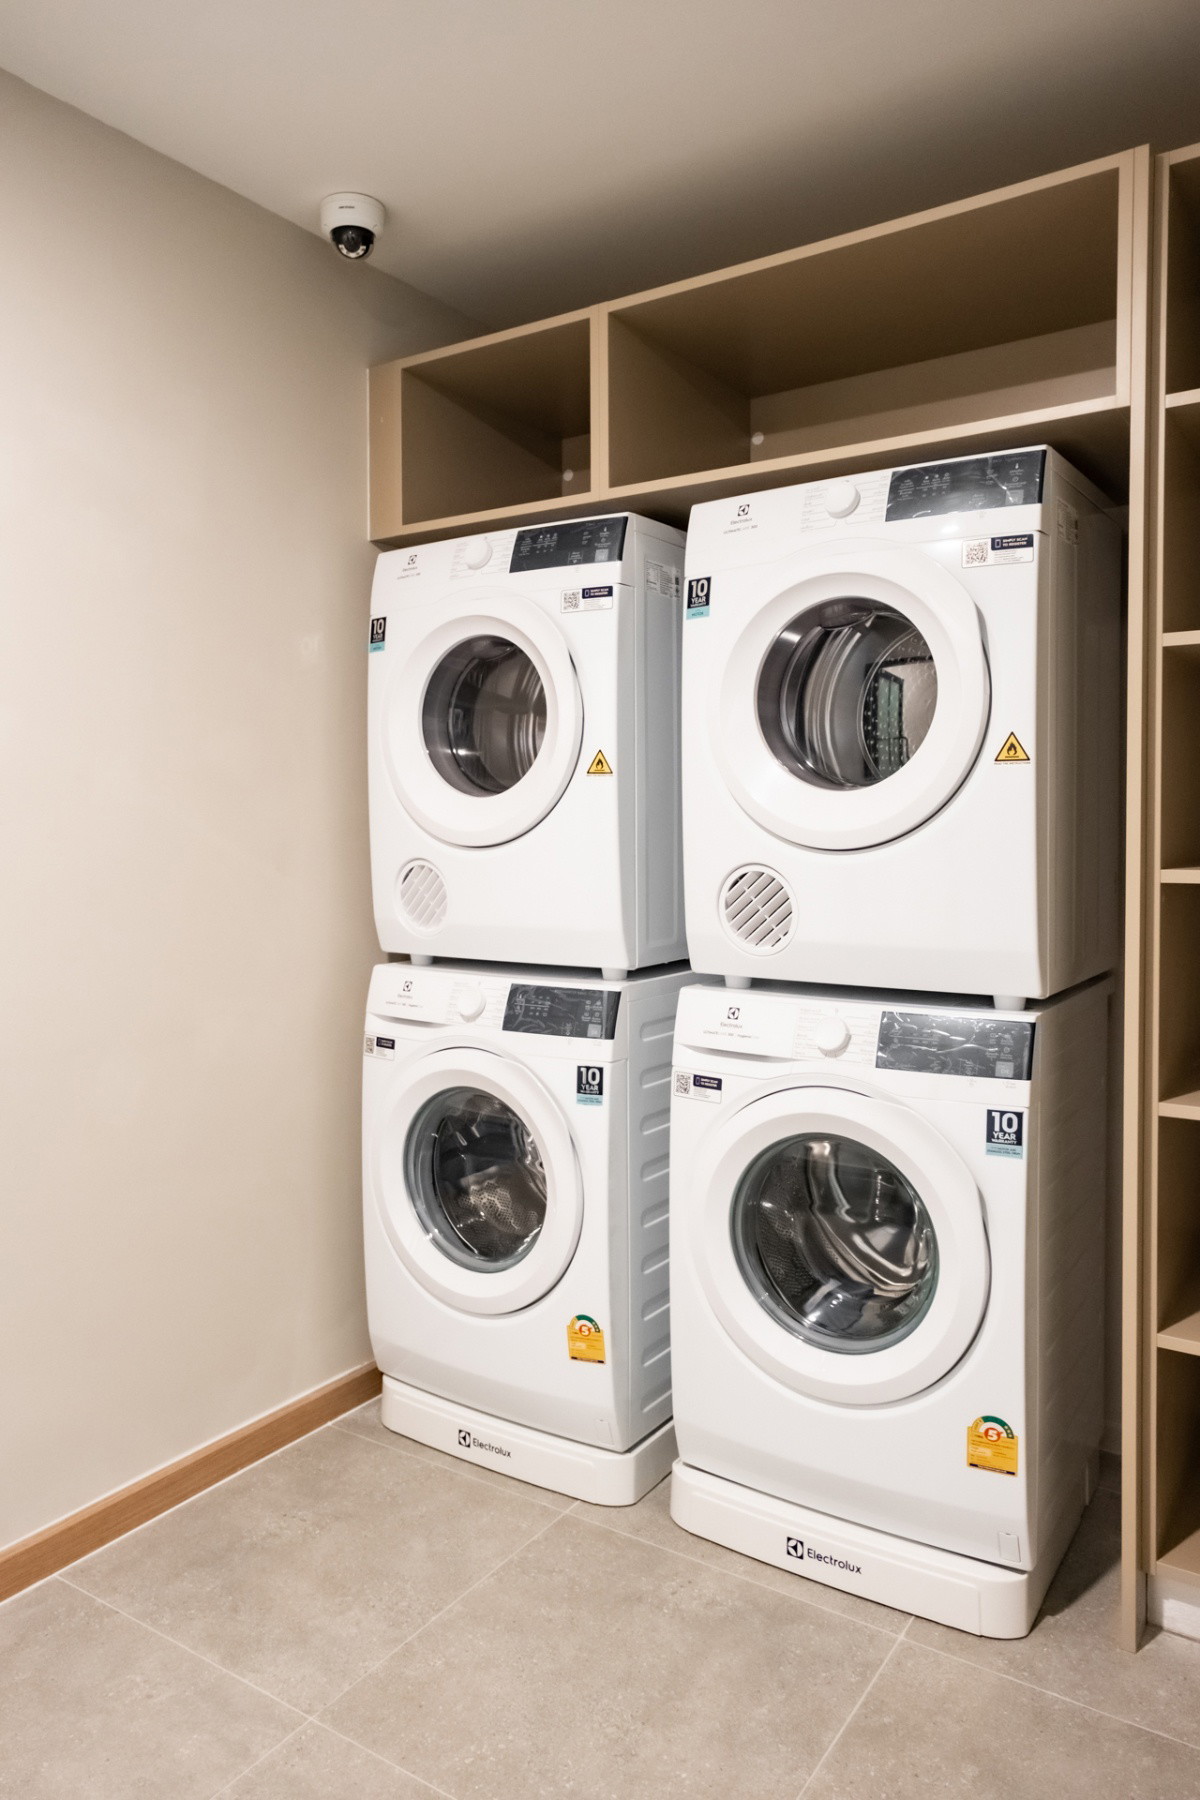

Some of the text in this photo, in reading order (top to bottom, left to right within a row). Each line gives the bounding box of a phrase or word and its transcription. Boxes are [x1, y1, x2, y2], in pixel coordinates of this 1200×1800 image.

[691, 579, 708, 598] 10
[691, 596, 706, 604] YEAR
[373, 618, 384, 635] 10
[580, 1067, 600, 1085] 10
[991, 1111, 1018, 1133] 10
[993, 1131, 1017, 1141] YEAR
[987, 1429, 999, 1441] 5
[472, 1437, 512, 1458] Electrolux
[807, 1548, 862, 1575] Electrolux
